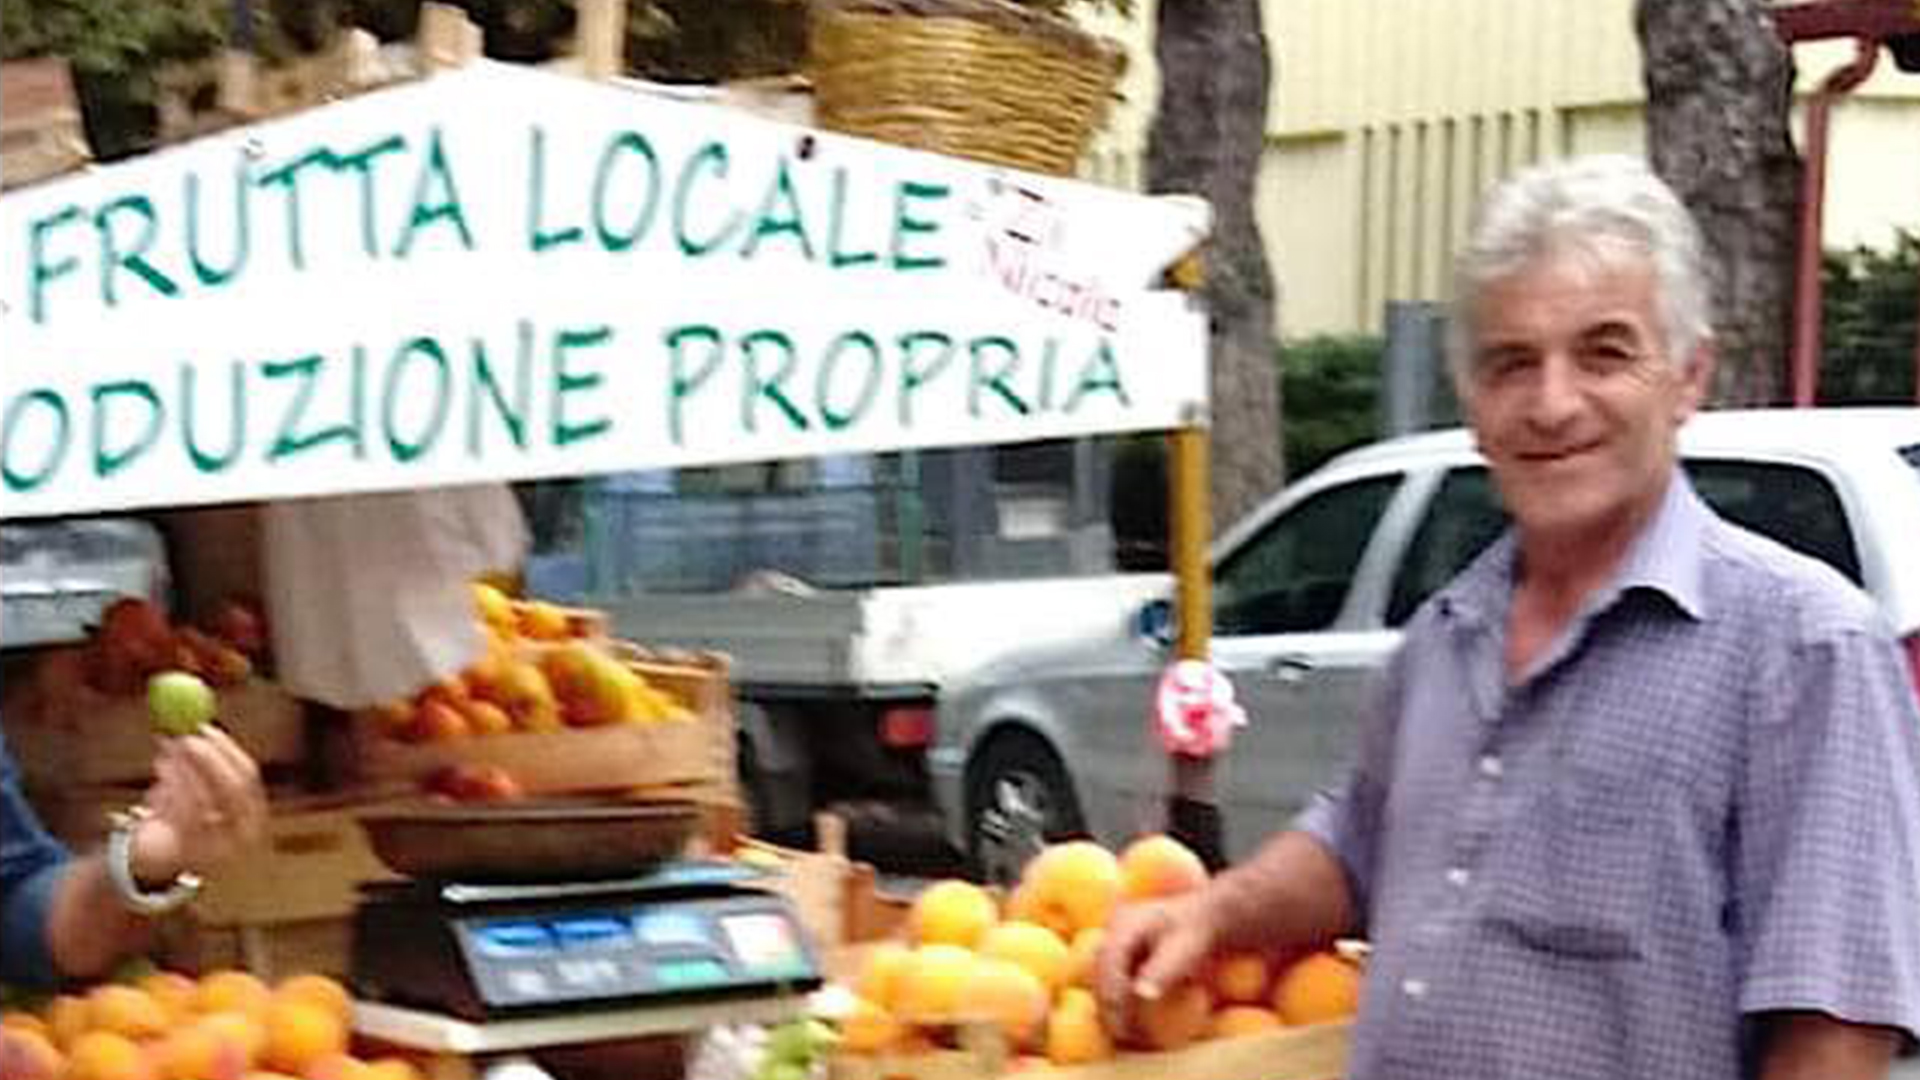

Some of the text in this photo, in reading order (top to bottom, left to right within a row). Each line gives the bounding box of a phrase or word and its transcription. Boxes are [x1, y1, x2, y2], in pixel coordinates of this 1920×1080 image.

[27, 124, 951, 325] FRUTTA LOCALE
[666, 324, 1131, 446] PROPRIA
